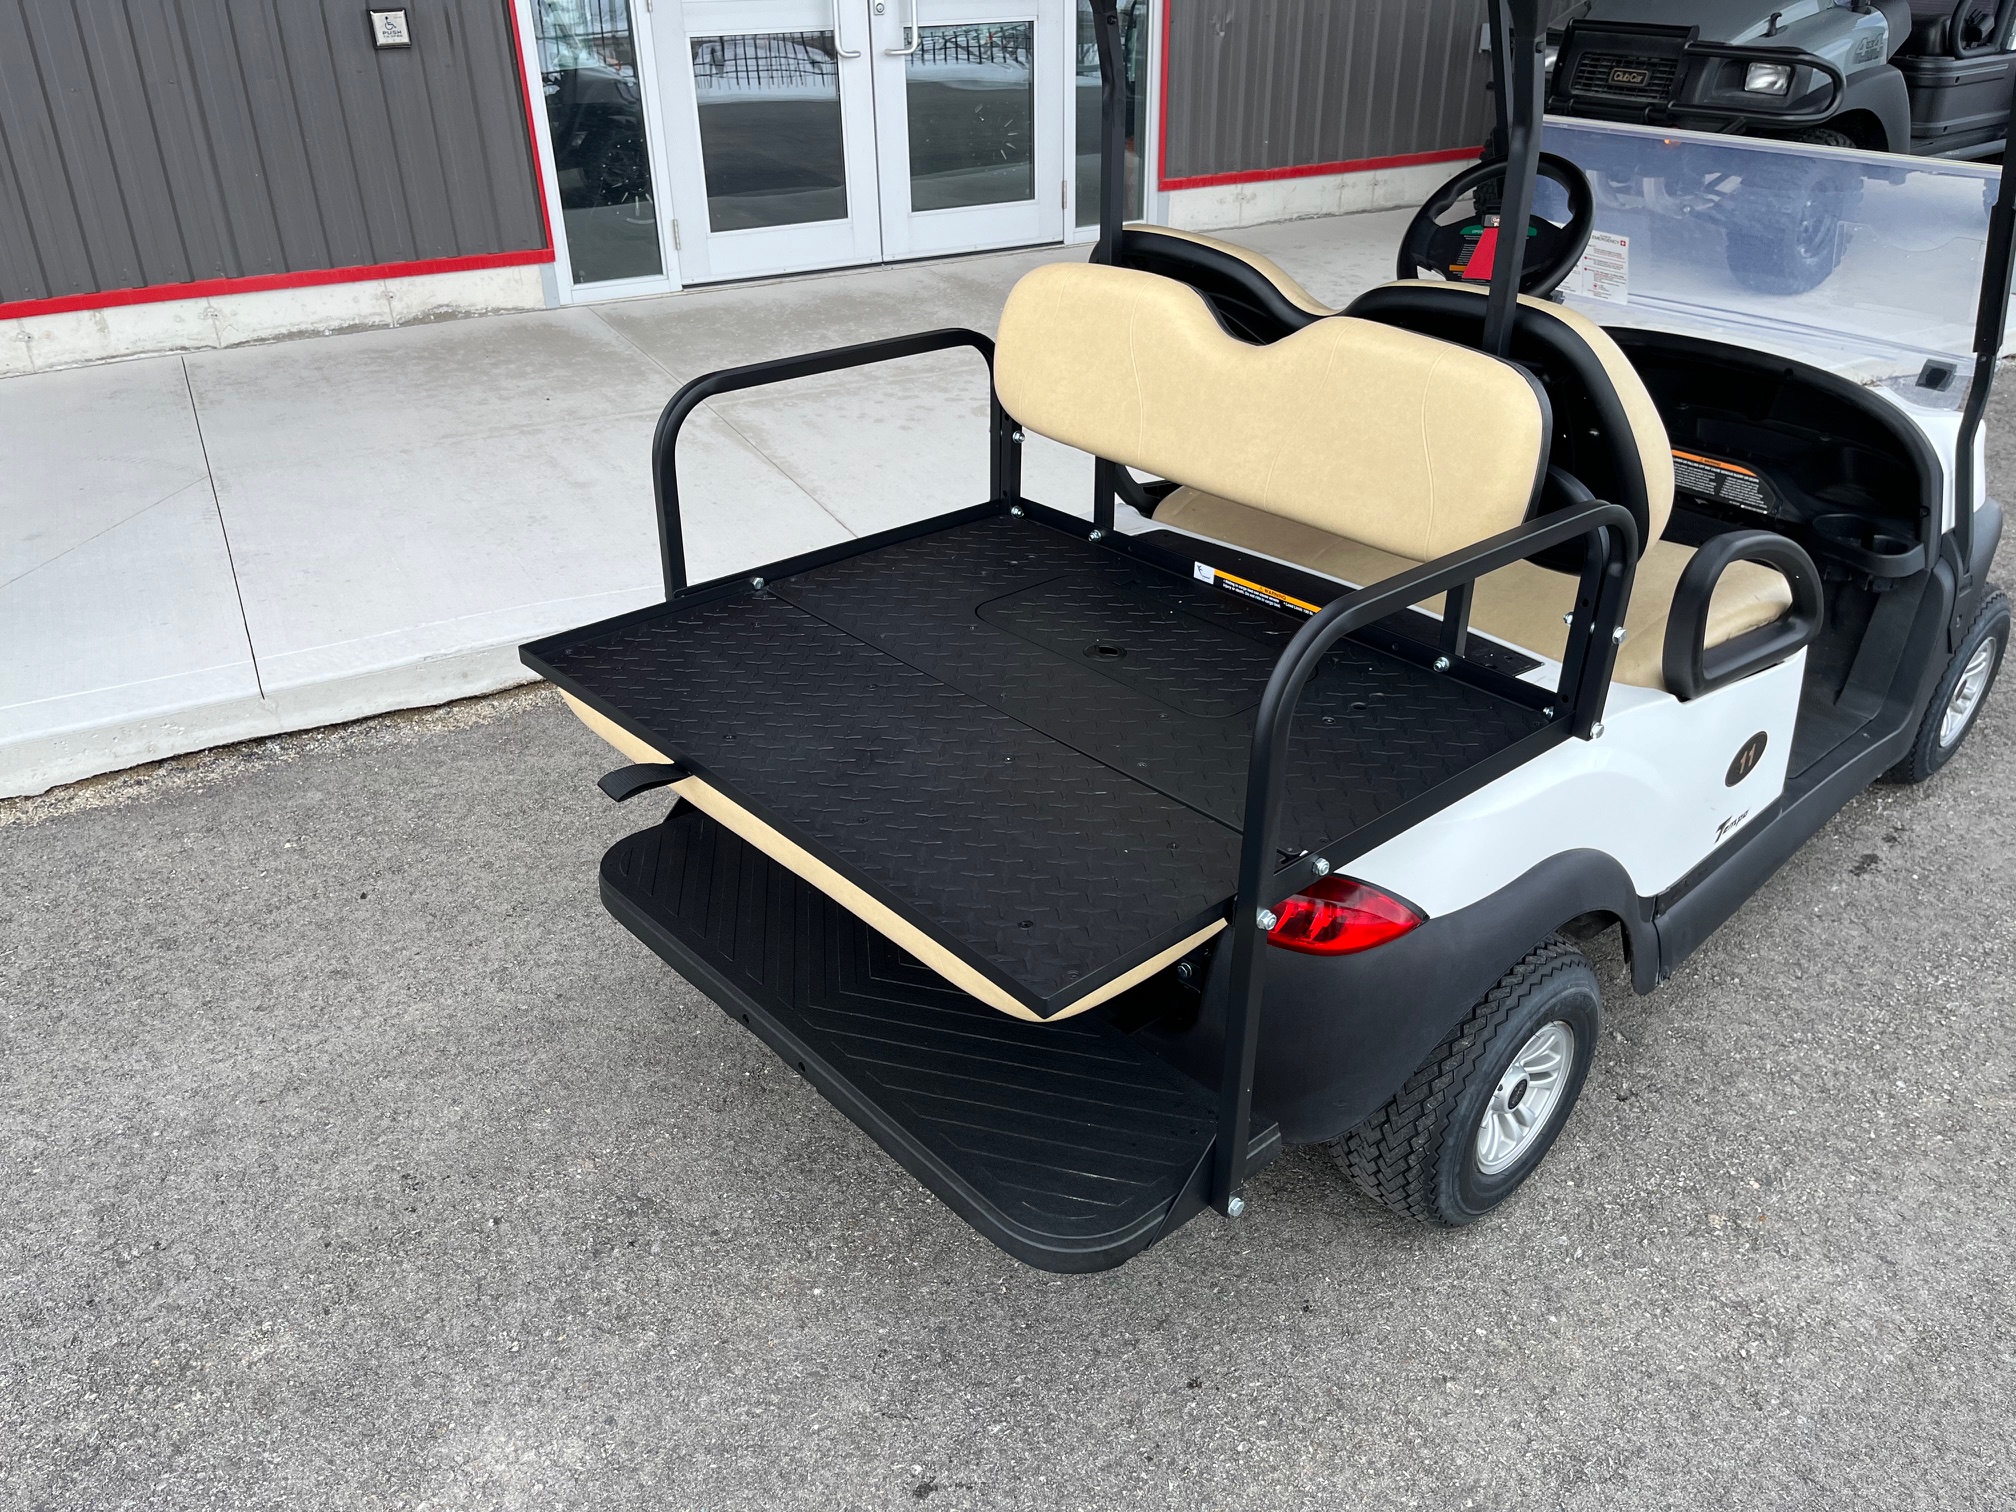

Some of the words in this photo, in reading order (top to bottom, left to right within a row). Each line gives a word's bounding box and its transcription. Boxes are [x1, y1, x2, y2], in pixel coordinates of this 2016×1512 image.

[1614, 72, 1630, 81] Club
[1630, 73, 1644, 82] Car
[1591, 234, 1620, 245] EMERGENCY
[1264, 589, 1287, 600] WARNING
[1739, 743, 1756, 775] 11
